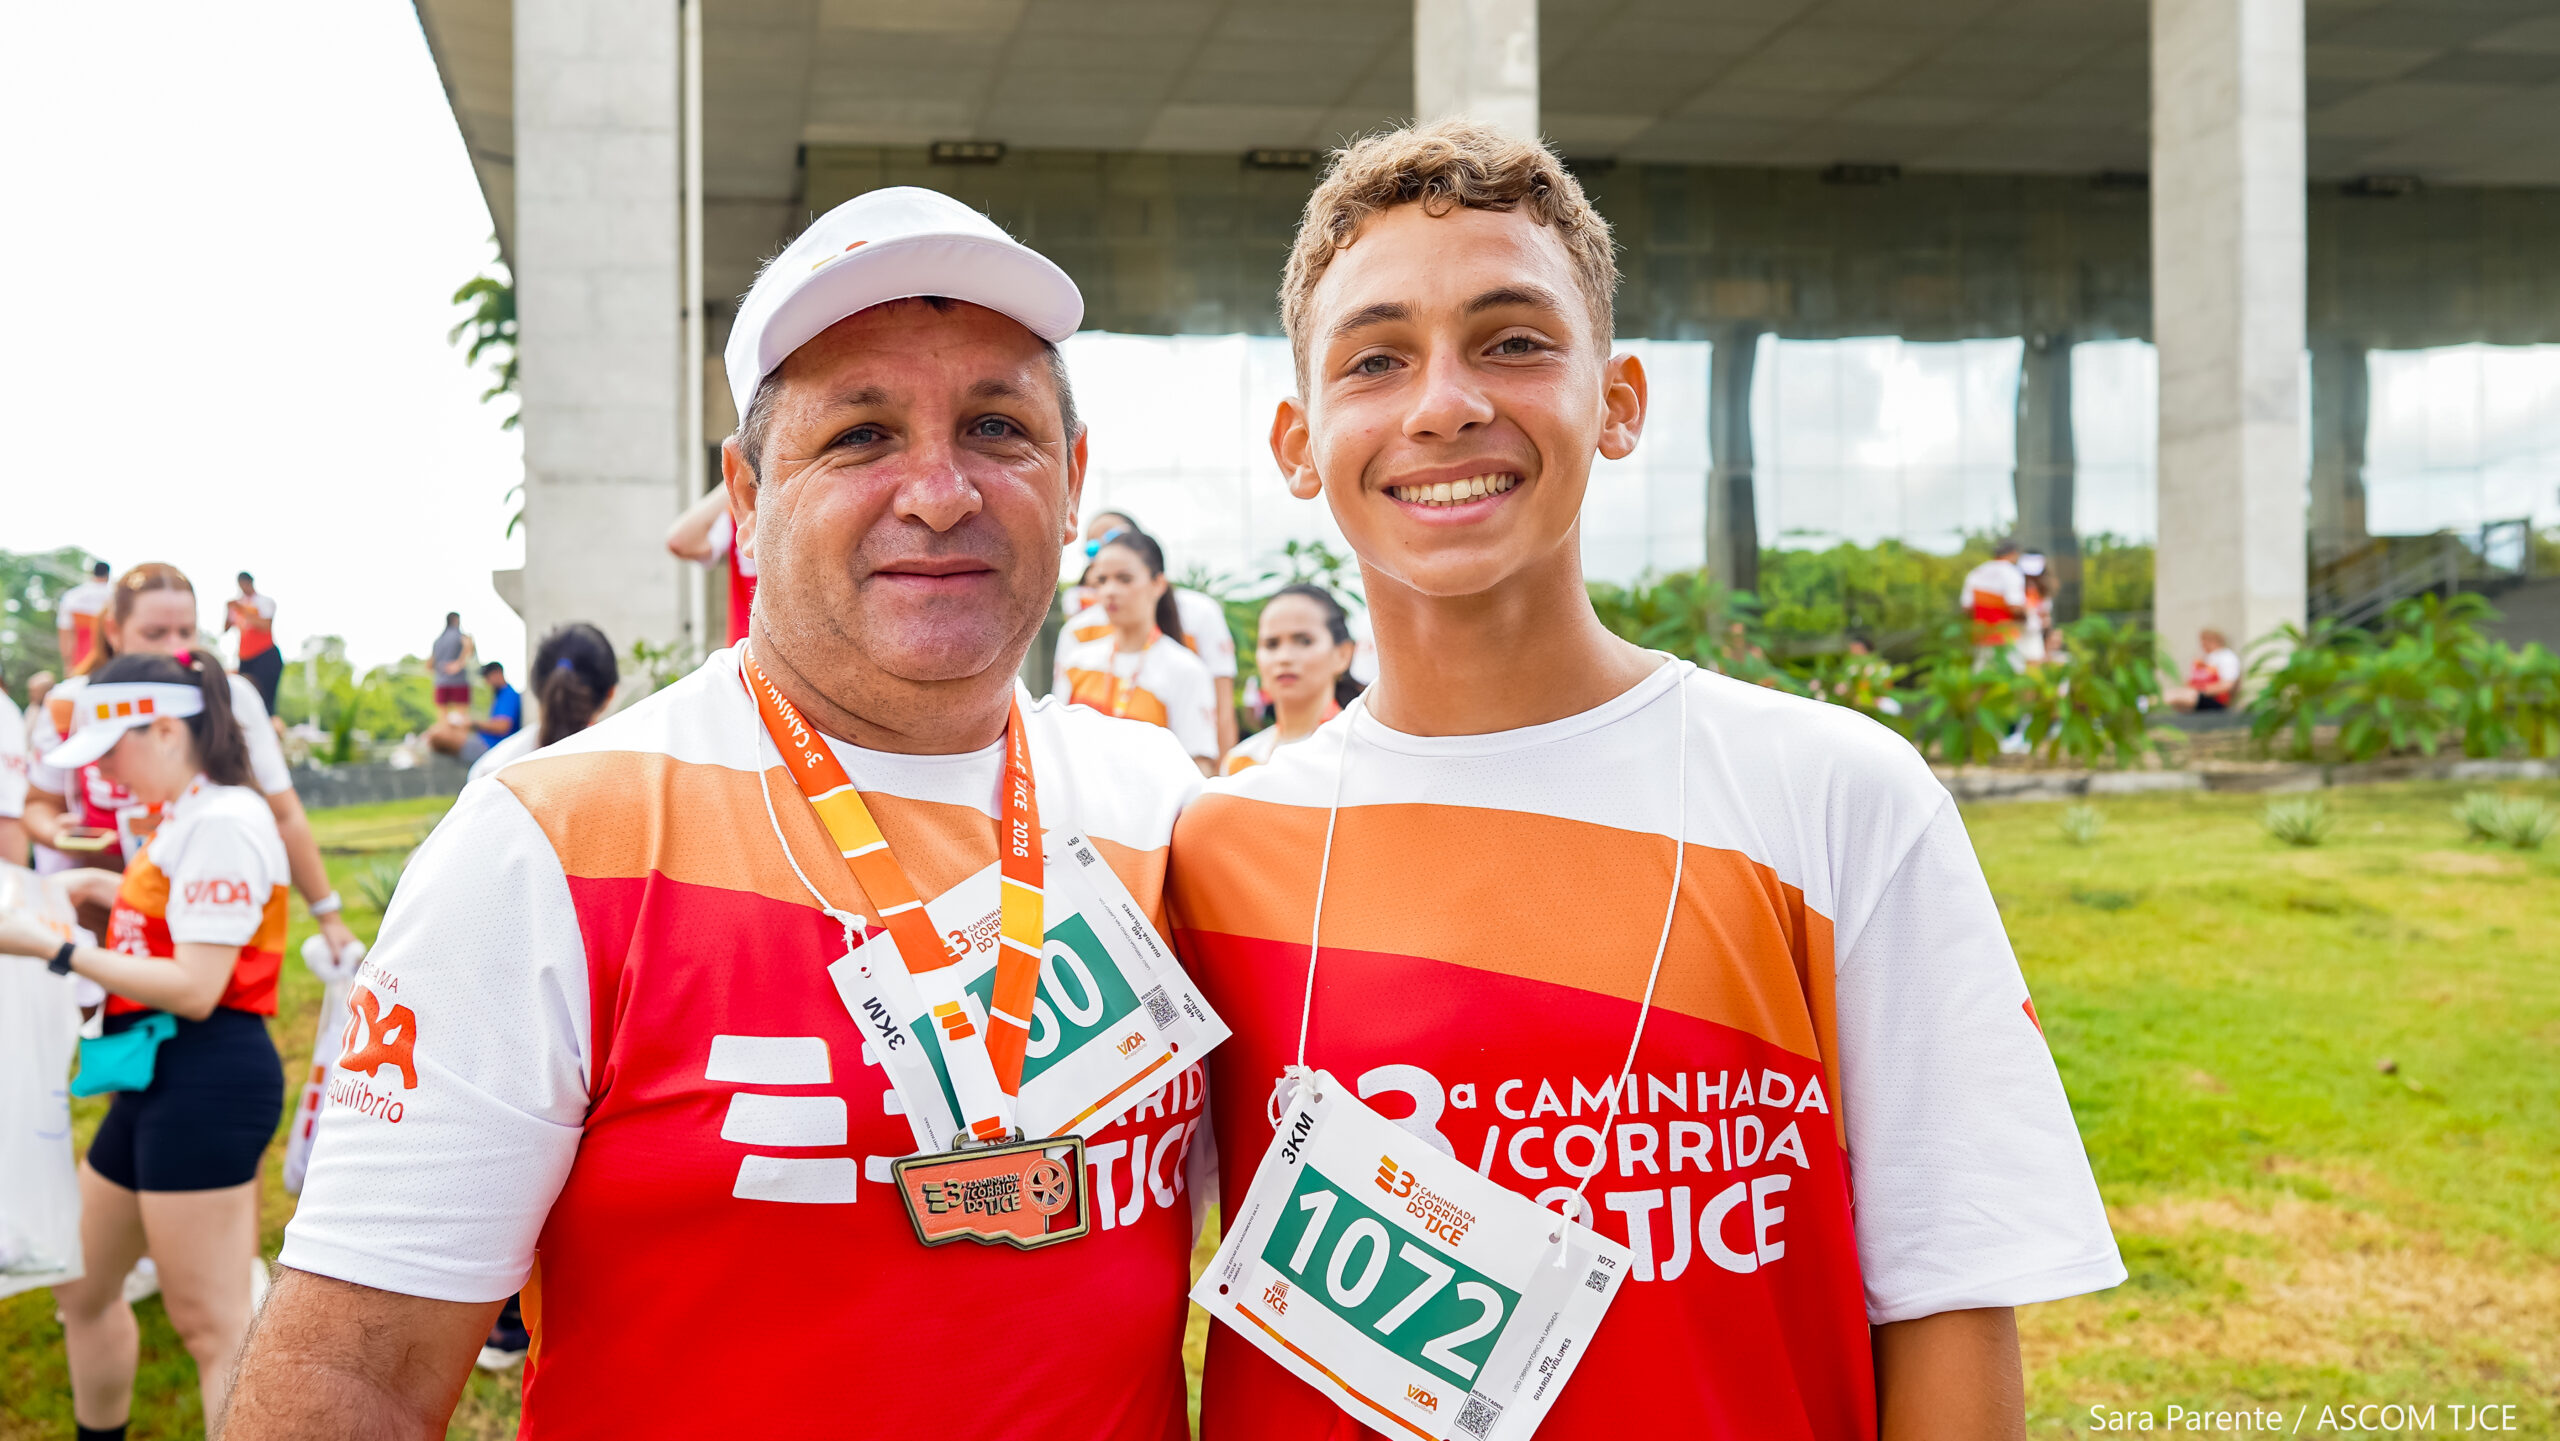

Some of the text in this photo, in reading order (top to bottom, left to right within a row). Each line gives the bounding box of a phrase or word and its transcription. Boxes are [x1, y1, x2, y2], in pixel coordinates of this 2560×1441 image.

[1012, 818, 1029, 859] 2026
[1066, 836, 1080, 848] 460
[968, 906, 1002, 933] CAMINHA
[971, 917, 1002, 942] /CORR
[976, 937, 994, 953] DO
[1183, 993, 1205, 1021] MEDALHA
[862, 996, 906, 1051] 3KM
[1496, 1068, 1829, 1119] CAMINHADA
[1281, 1111, 1314, 1165] 3KM
[965, 1199, 985, 1214] DO
[984, 1193, 1022, 1216] TJCE
[1420, 1187, 1476, 1224] CAMINHADA
[1406, 1201, 1465, 1247] DO TJCE
[1605, 1174, 1792, 1283] TJCE
[1597, 1254, 1617, 1269] 1072
[1288, 1189, 1504, 1381] 1072
[1263, 1288, 1288, 1315] TJCE
[1533, 1338, 1572, 1401] GUARDA-VOLUMES
[1538, 1356, 1552, 1374] 1072
[1407, 1384, 1438, 1411] VIDA
[1512, 1380, 1521, 1392] USO
[1472, 1389, 1504, 1411] RESULTADOS
